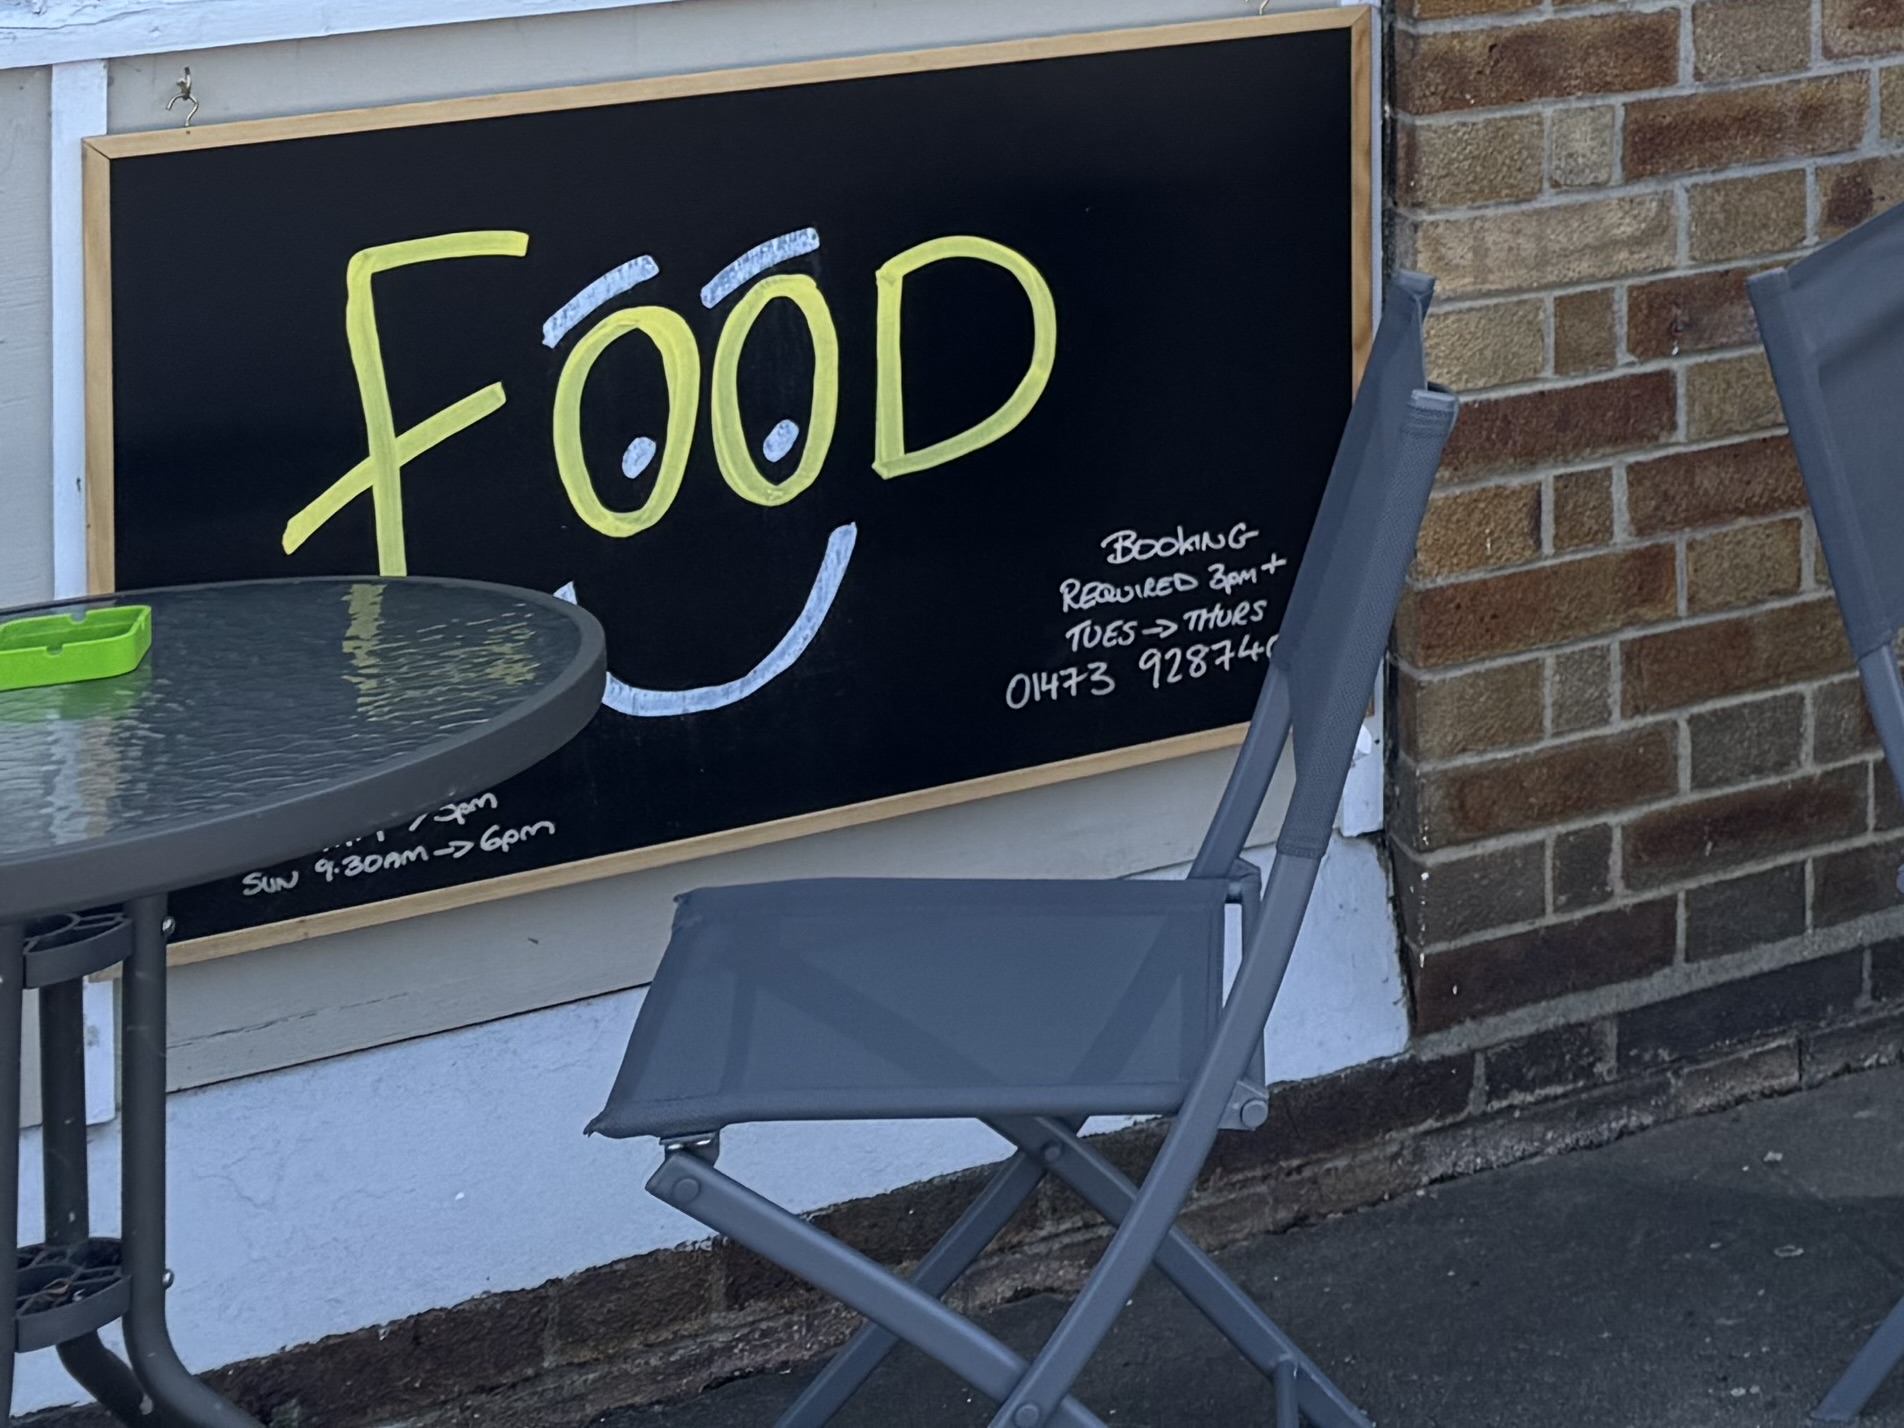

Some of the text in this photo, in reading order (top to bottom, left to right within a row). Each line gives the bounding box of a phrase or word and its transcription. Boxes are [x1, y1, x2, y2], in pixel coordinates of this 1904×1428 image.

[281, 230, 1057, 578] FOOD
[1100, 522, 1260, 565] BOOKING
[1059, 572, 1199, 613] REQUIRED
[1065, 599, 1268, 653] TUES THURS
[1005, 662, 1116, 710] 01473
[242, 869, 299, 897] SUN
